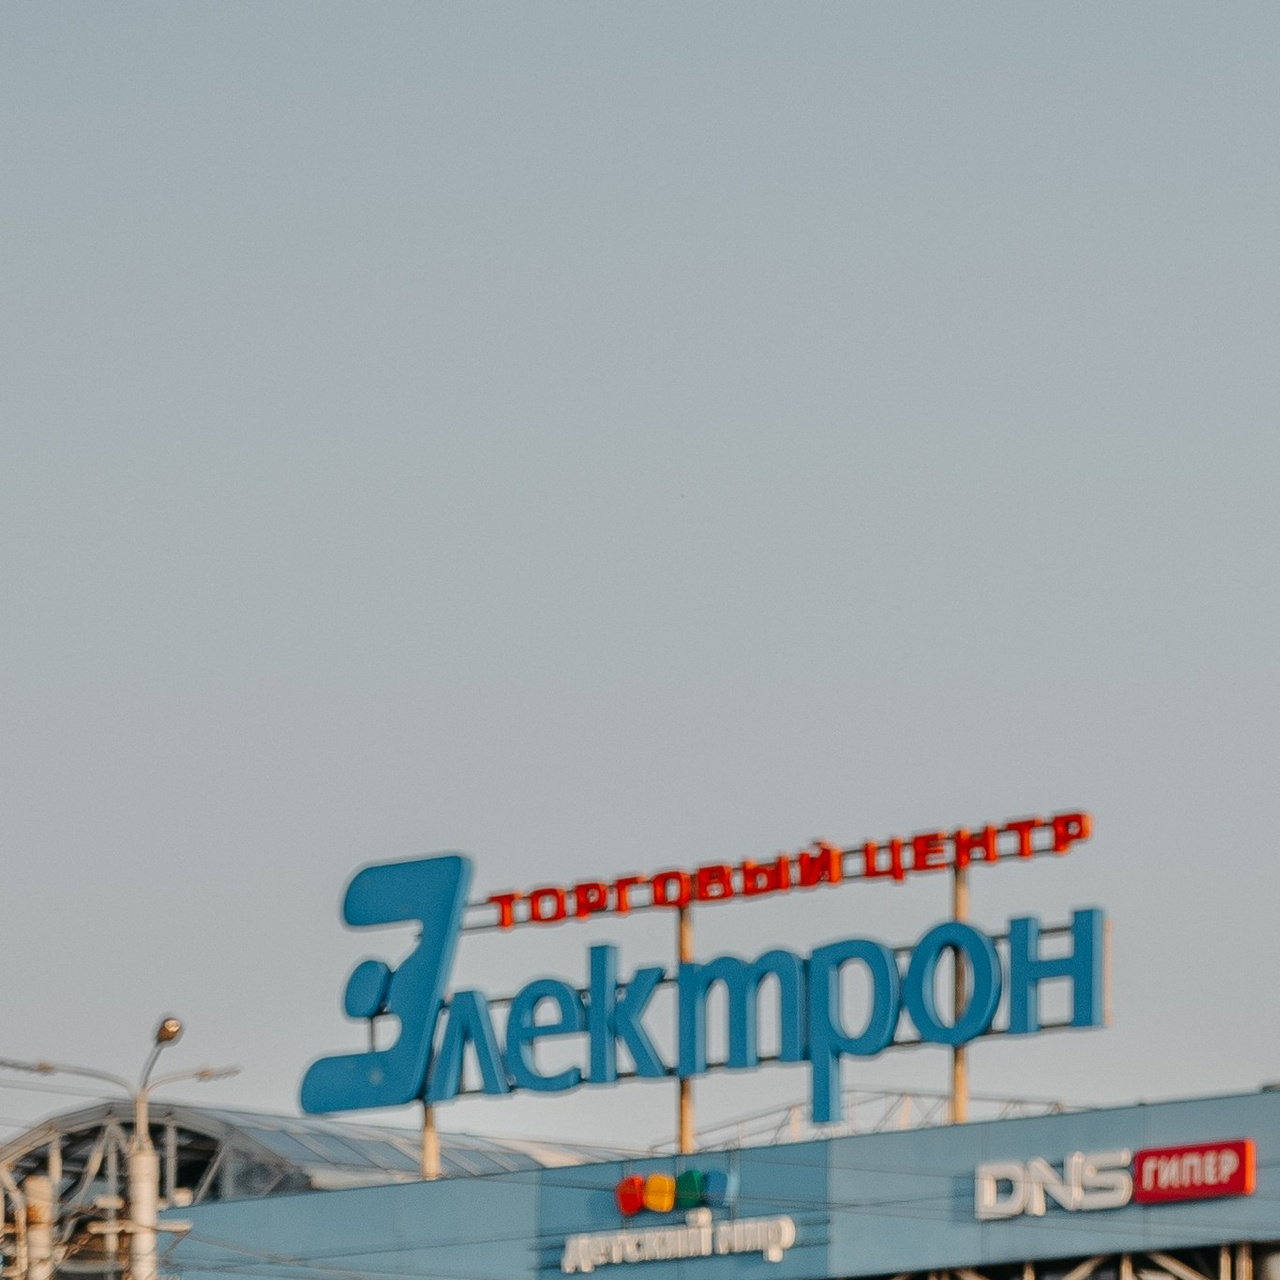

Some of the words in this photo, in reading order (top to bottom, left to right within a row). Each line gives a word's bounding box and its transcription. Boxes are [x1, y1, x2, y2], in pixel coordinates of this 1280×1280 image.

[489, 841, 843, 929] ТОРГОВЫЙ
[862, 812, 1092, 882] ЦЕНТР
[300, 855, 1107, 1122] Электрон
[975, 1148, 1133, 1220] DNS
[1141, 1147, 1240, 1192] ГИПЕР
